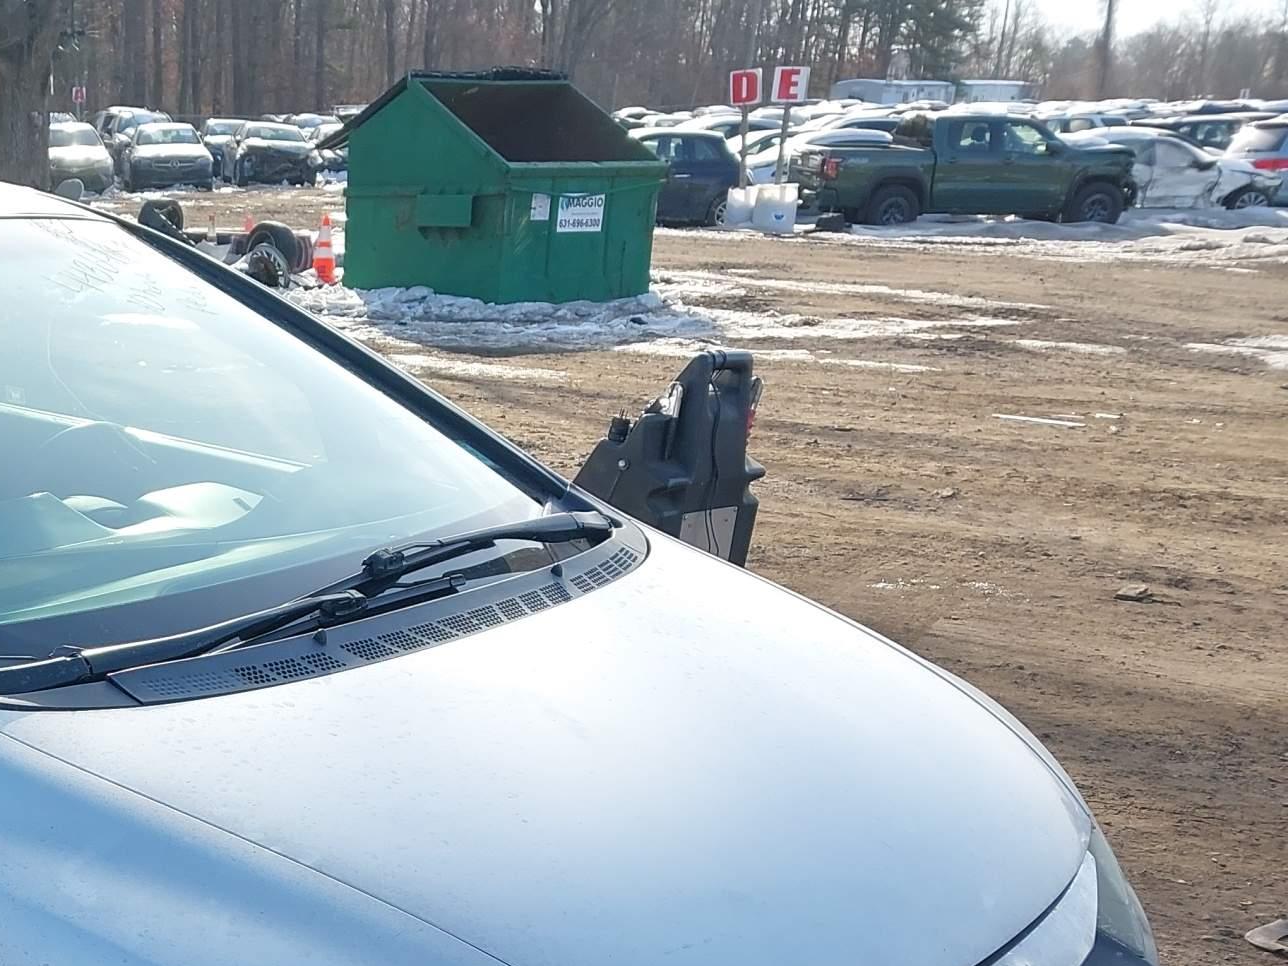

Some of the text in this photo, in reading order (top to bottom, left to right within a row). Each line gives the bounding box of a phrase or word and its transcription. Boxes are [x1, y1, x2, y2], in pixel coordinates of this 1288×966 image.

[732, 71, 758, 103] D
[777, 69, 801, 99] E
[568, 196, 604, 208] MAGGIO
